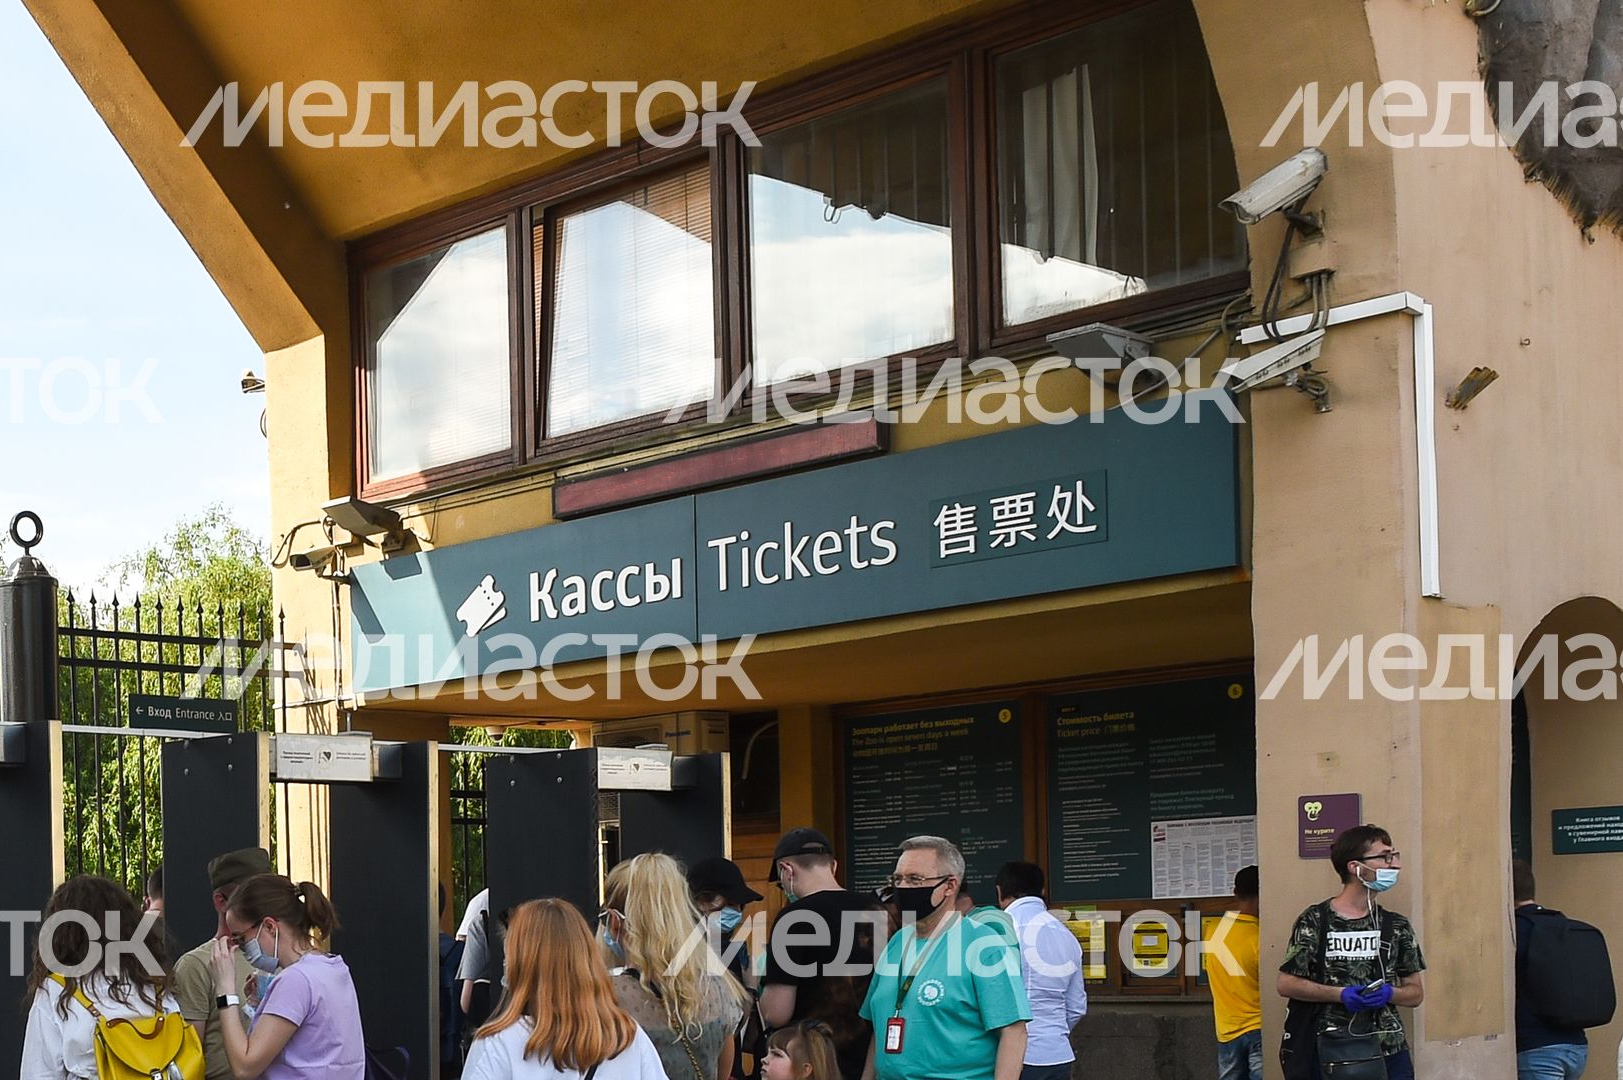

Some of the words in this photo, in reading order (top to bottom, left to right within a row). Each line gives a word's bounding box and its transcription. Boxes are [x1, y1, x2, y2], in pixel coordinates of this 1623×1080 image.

[932, 480, 1098, 559] 售票处
[707, 515, 898, 593] Tickets
[528, 557, 683, 622] Кассы
[147, 705, 172, 719] Вход
[175, 708, 215, 721] Entrance
[217, 711, 233, 721] 入口
[1057, 714, 1102, 727] Стоимость
[1103, 711, 1135, 722] билета
[852, 726, 883, 736] Зоопарк
[884, 722, 919, 734] работает
[920, 720, 933, 729] без
[1057, 727, 1080, 738] Ticket
[1081, 726, 1100, 737] price
[1313, 828, 1335, 836] курите
